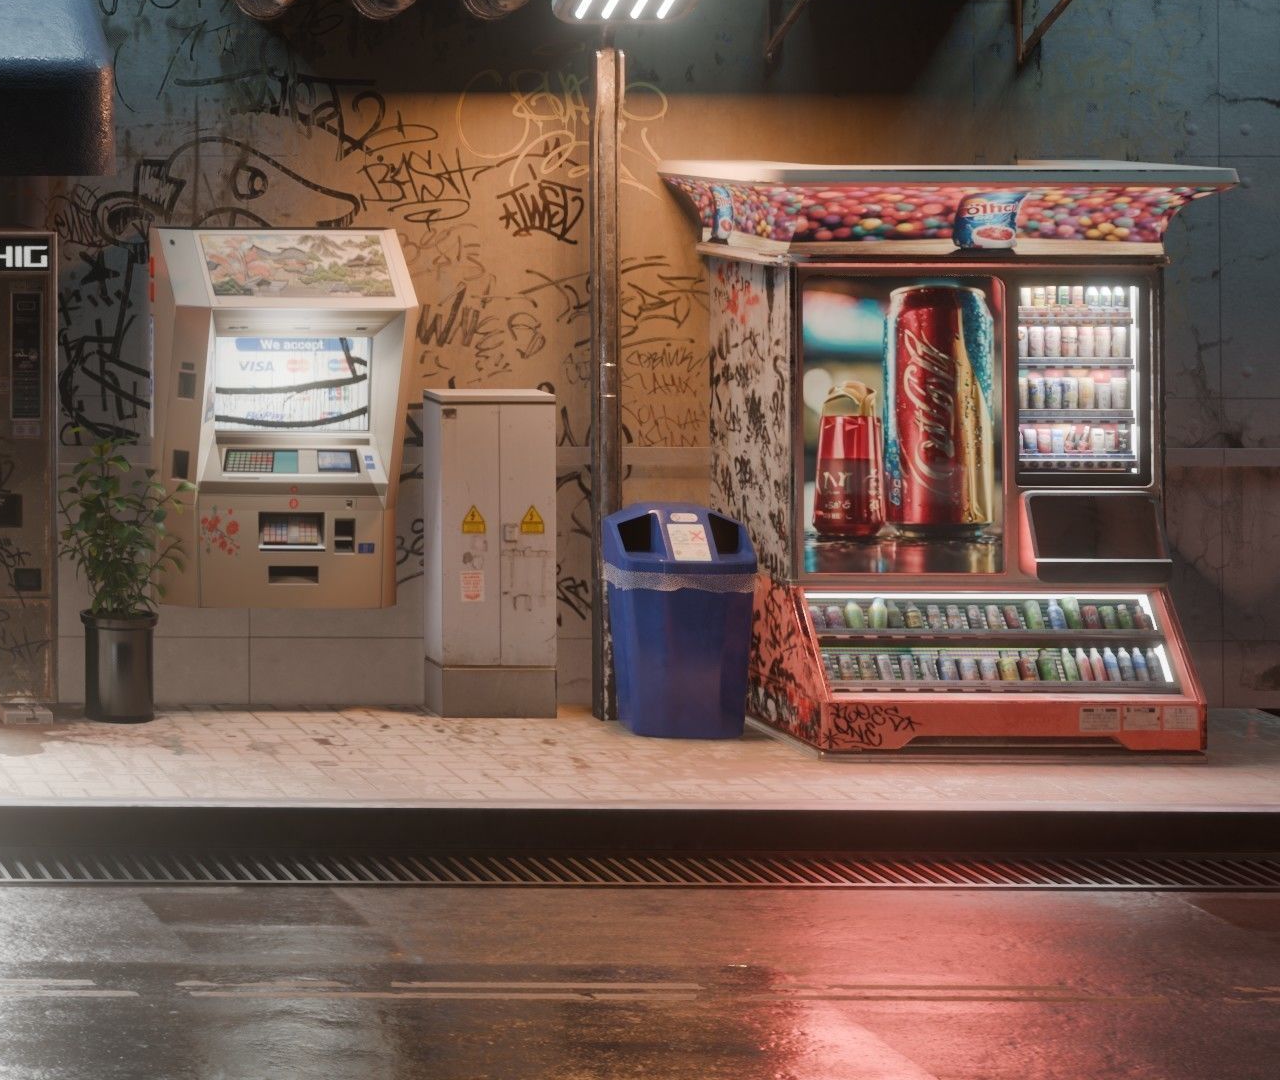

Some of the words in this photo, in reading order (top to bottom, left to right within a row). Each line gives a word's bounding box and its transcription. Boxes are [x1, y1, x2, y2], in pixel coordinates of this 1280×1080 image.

[259, 338, 278, 350] We
[284, 339, 325, 351] accept
[239, 360, 275, 372] VISA
